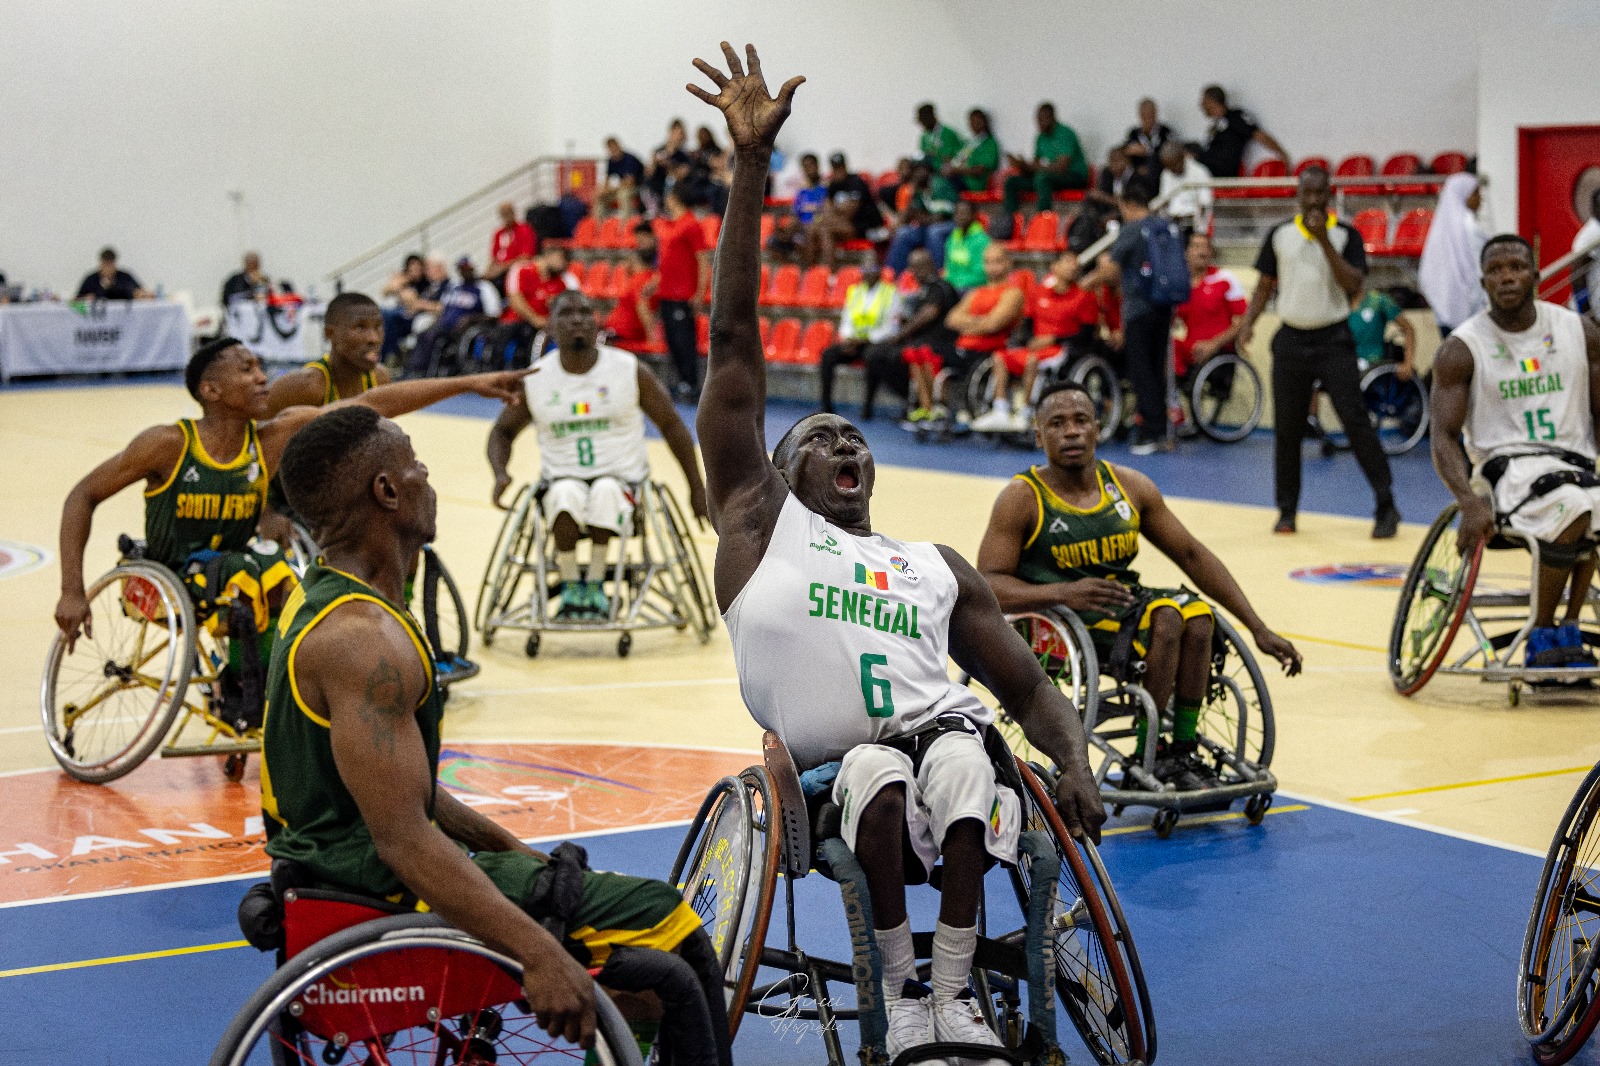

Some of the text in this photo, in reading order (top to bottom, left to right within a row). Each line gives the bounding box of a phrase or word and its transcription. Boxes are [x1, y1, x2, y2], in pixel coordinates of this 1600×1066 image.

[1498, 372, 1564, 400] SENEGAL
[1523, 408, 1556, 441] 15
[577, 437, 594, 466] 8
[175, 493, 221, 519] SOUTH
[1051, 539, 1100, 569] SOUTH
[809, 582, 921, 639] SENEGAL
[860, 653, 894, 718] 6
[840, 880, 874, 1010] DECATHLON
[303, 983, 425, 1005] Chairman
